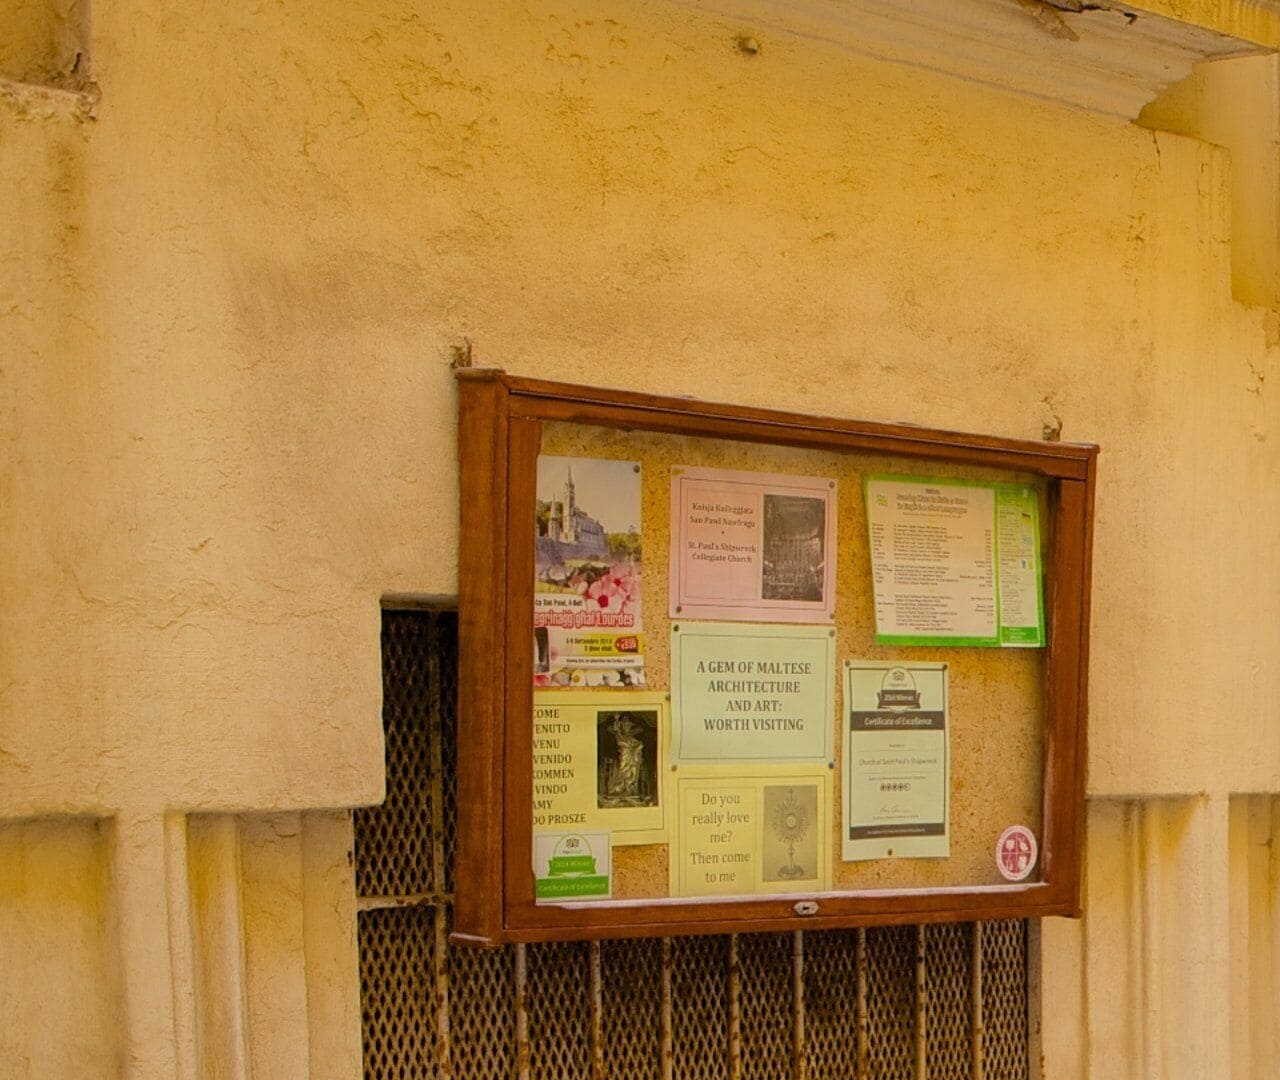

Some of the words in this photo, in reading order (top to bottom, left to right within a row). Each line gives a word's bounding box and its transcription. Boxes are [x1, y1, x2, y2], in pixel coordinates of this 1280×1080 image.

[692, 502, 714, 512] Knisja
[689, 516, 703, 524] San
[704, 517, 721, 525] Pawl
[698, 541, 719, 550] Paul's
[720, 543, 757, 552] Shipwreck
[692, 552, 726, 562] Collegiate
[727, 554, 753, 563] Church
[595, 610, 635, 628] Lourdes
[696, 660, 705, 673] A
[708, 661, 735, 673] GEM
[737, 661, 754, 674] OF
[756, 662, 812, 675] MALTESE
[707, 680, 801, 693] ARCHITECTURE
[726, 699, 752, 712] AND
[754, 699, 783, 712] ART:
[533, 709, 560, 719] OME
[703, 718, 750, 731] WORTH
[752, 718, 804, 731] VISITING
[864, 716, 894, 726] Certificate
[534, 723, 570, 734] ENUTO
[701, 792, 717, 805] Do
[719, 794, 741, 807] you
[548, 813, 587, 825] PROSZE
[691, 811, 724, 827] really
[726, 811, 751, 824] love
[709, 830, 733, 843] me?
[690, 852, 719, 865] Then
[721, 853, 751, 863] come
[705, 872, 717, 883] to
[719, 872, 737, 882] me
